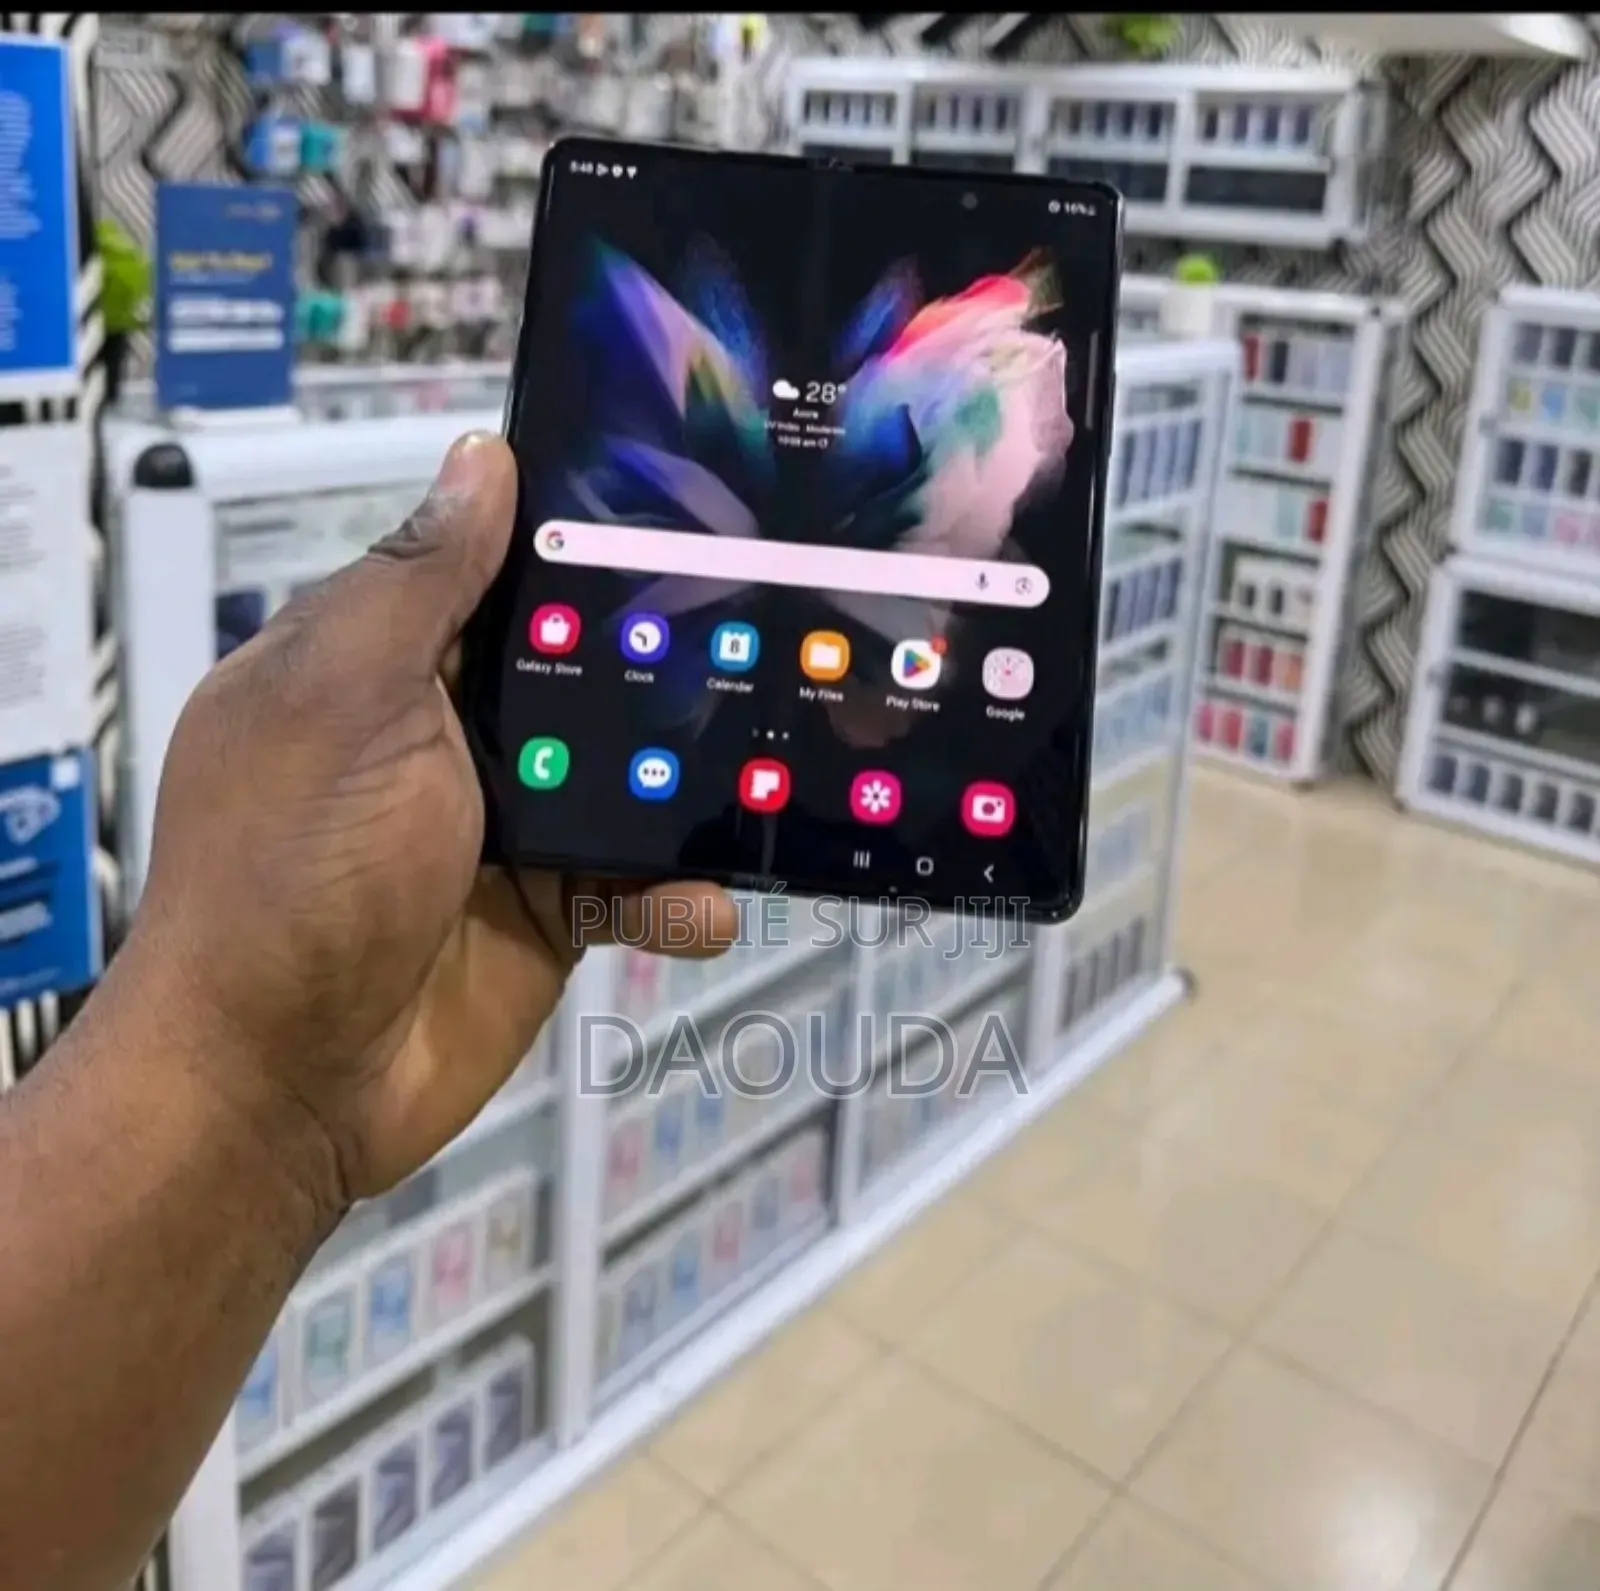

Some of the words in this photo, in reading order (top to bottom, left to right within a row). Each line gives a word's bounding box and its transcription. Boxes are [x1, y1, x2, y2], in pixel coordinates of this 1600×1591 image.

[516, 658, 551, 675] Galaxy
[554, 661, 583, 676] Store
[624, 669, 654, 683] Clock
[705, 677, 754, 693] Calendar
[799, 686, 816, 702] My
[817, 688, 844, 702] Files
[886, 695, 910, 712] Play
[912, 697, 940, 712] Store
[986, 706, 1025, 722] Google
